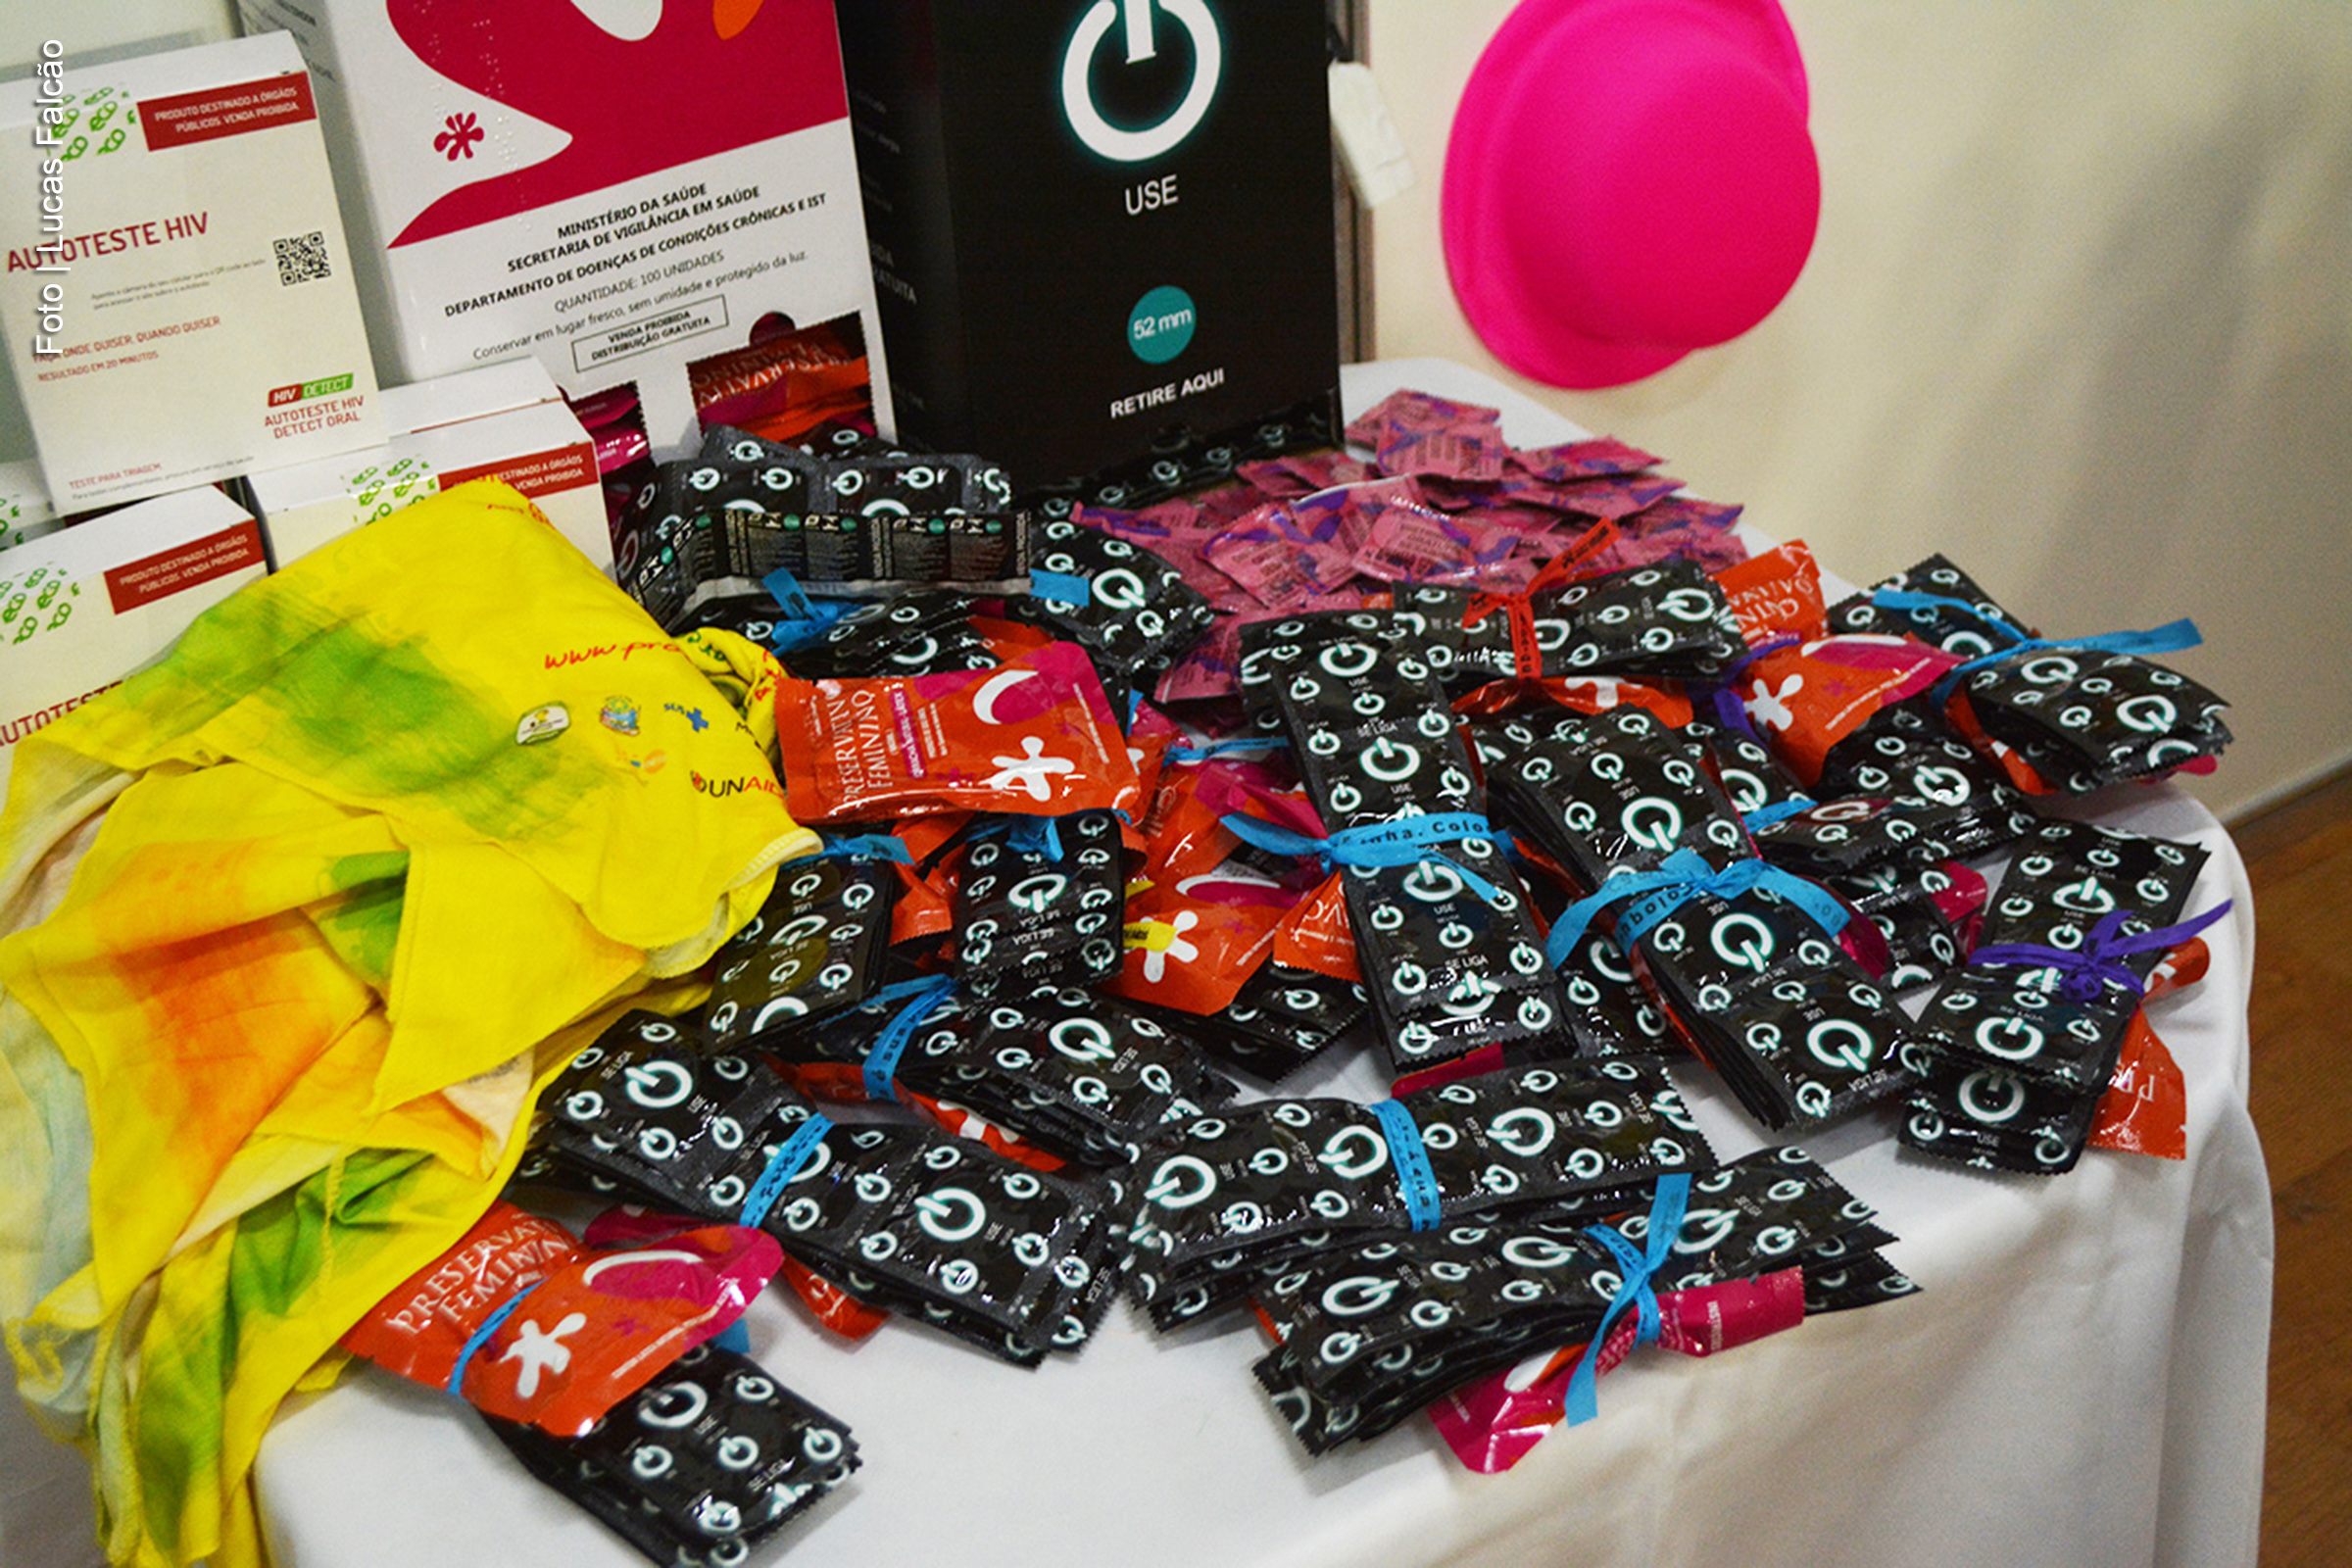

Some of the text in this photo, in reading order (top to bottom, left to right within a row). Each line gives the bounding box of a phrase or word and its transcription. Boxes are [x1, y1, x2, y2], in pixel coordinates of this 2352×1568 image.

[154, 107, 200, 122] PRODUTO
[223, 109, 256, 124] VENDA
[256, 101, 300, 118] PROIBIDA
[557, 183, 708, 239] MINISTÉRIO DA SAÚDE
[1124, 174, 1179, 216] USE
[6, 211, 209, 273] AUTOTESTE HIV
[507, 184, 760, 272] SECRETARIA DE VIGILÂNCIA EM SAÚDE
[444, 193, 827, 318] DEPARTAMENTO DE DOENÇAS DE CONDIÇÕES CRÔNICAS E IST
[640, 270, 661, 286] 100
[662, 248, 725, 278] UNIDADES
[472, 331, 533, 361] Conservar
[534, 327, 555, 342] em
[555, 316, 586, 339] lugar
[628, 298, 653, 315] sem
[654, 280, 704, 306] umidade
[705, 277, 713, 289] e
[714, 262, 770, 294] protegido
[772, 255, 788, 270] da
[608, 310, 692, 344] VENDA PROIBIDA
[1132, 308, 1193, 341] 52 mm
[591, 316, 711, 362] DISTRIBUIÇÃO GRATUITA
[273, 375, 350, 404] HIV DETECT
[1109, 368, 1225, 419] RETIRE AQUI
[265, 395, 365, 427] AUTOTESTE HIV
[273, 410, 362, 439] DETECT ORAL
[851, 689, 894, 789] FEMININO
